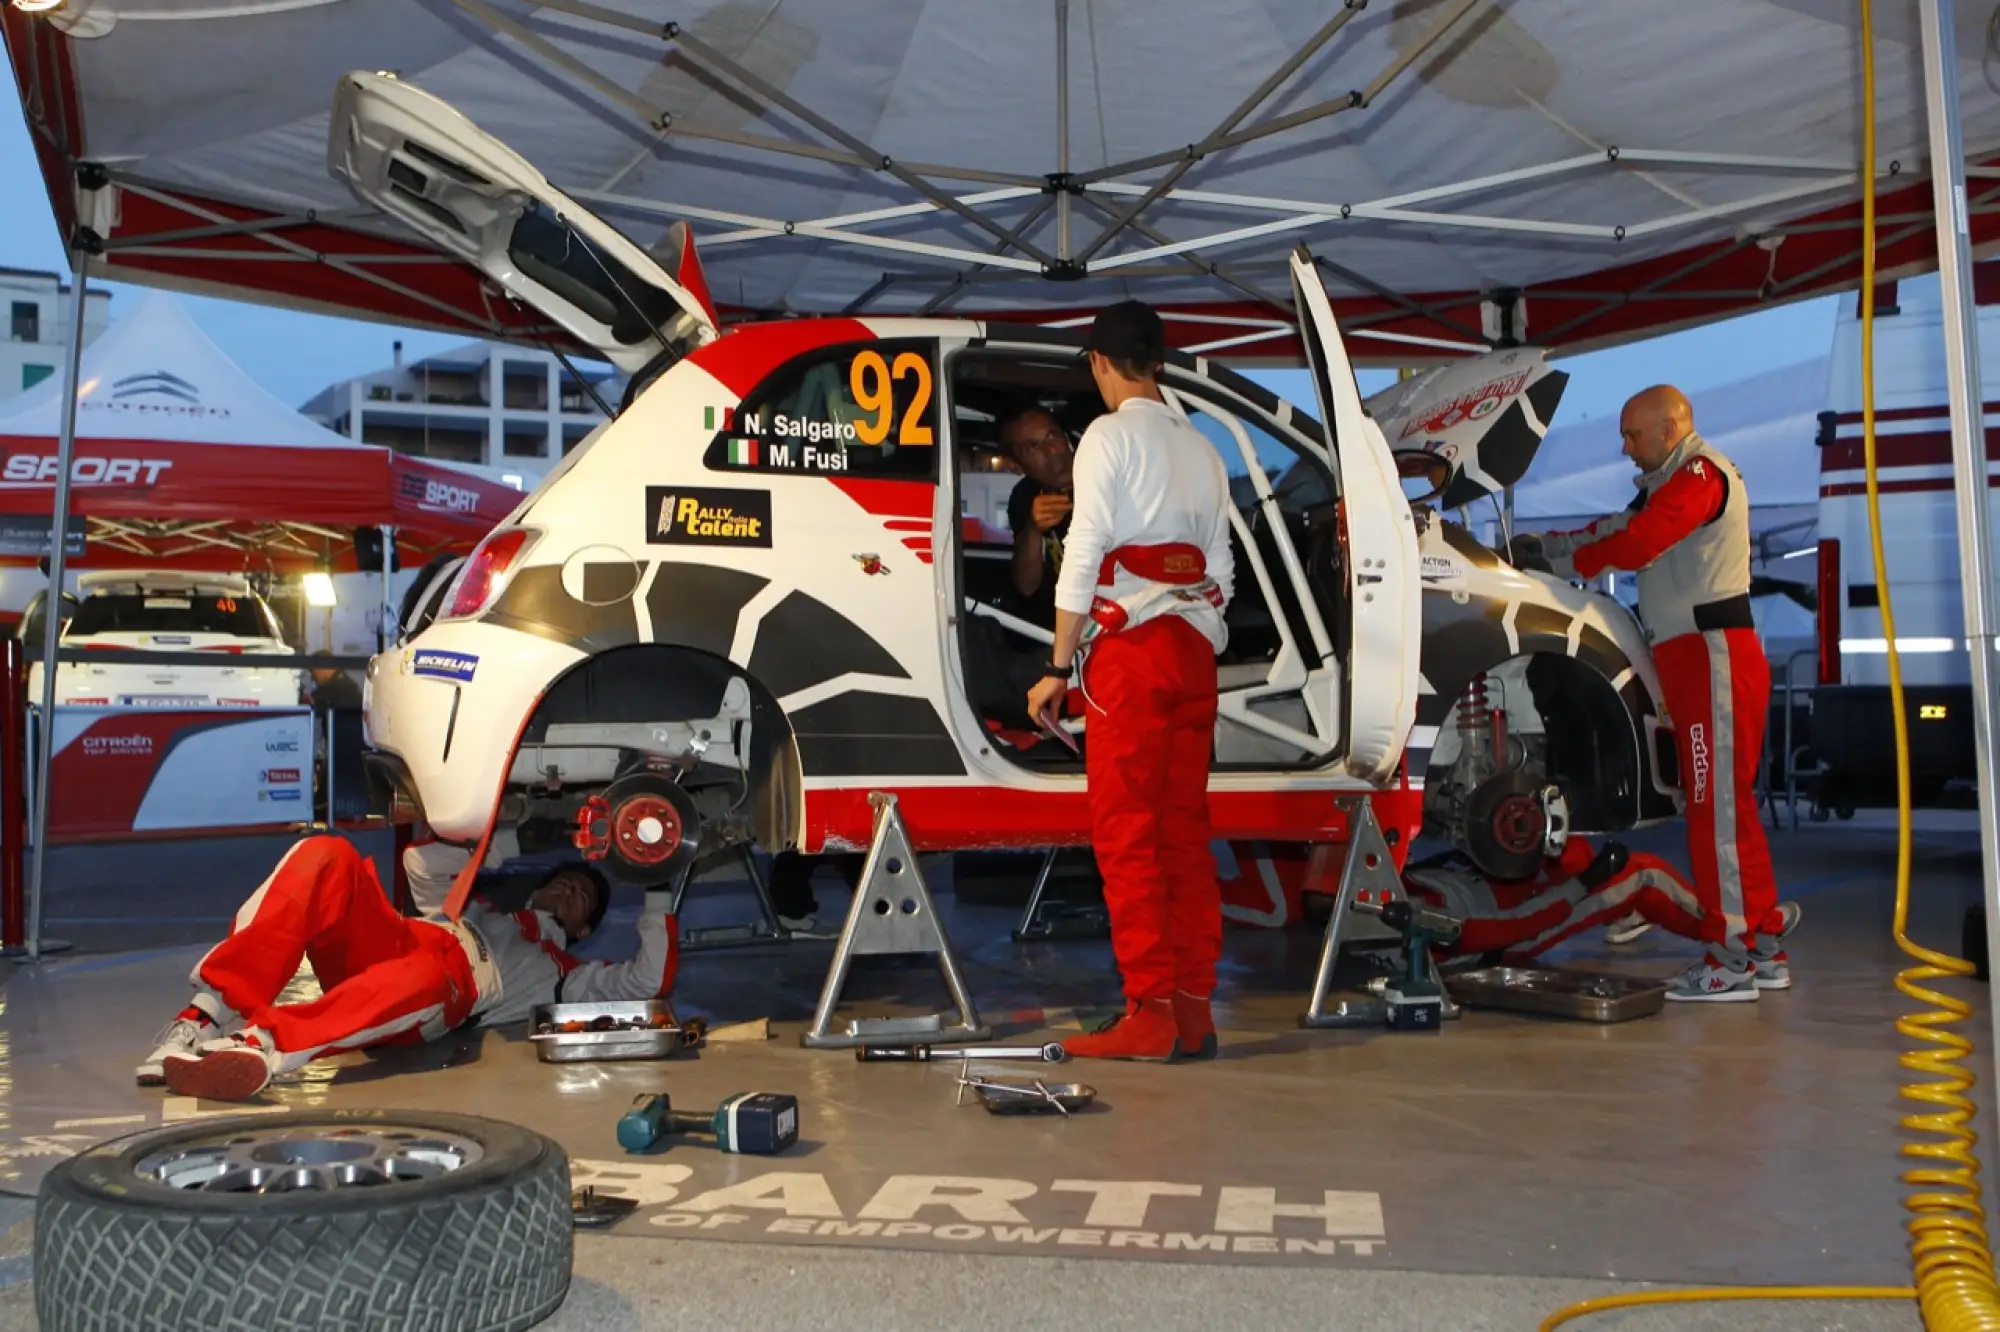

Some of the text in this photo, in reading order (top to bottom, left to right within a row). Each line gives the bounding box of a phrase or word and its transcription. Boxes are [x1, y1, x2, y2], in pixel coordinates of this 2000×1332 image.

[851, 350, 933, 445] 92
[744, 413, 856, 442] N. Salgaro
[2, 453, 173, 484] SPORT
[769, 444, 848, 471] M. Fusi
[425, 480, 480, 513] SPORT
[677, 497, 733, 522] RALLY
[687, 517, 762, 537] talent
[216, 598, 237, 613] 40
[416, 655, 477, 672] MICHELIN
[1690, 722, 1709, 804] kappa
[650, 1212, 1386, 1257] OF EMPOWERMENT
